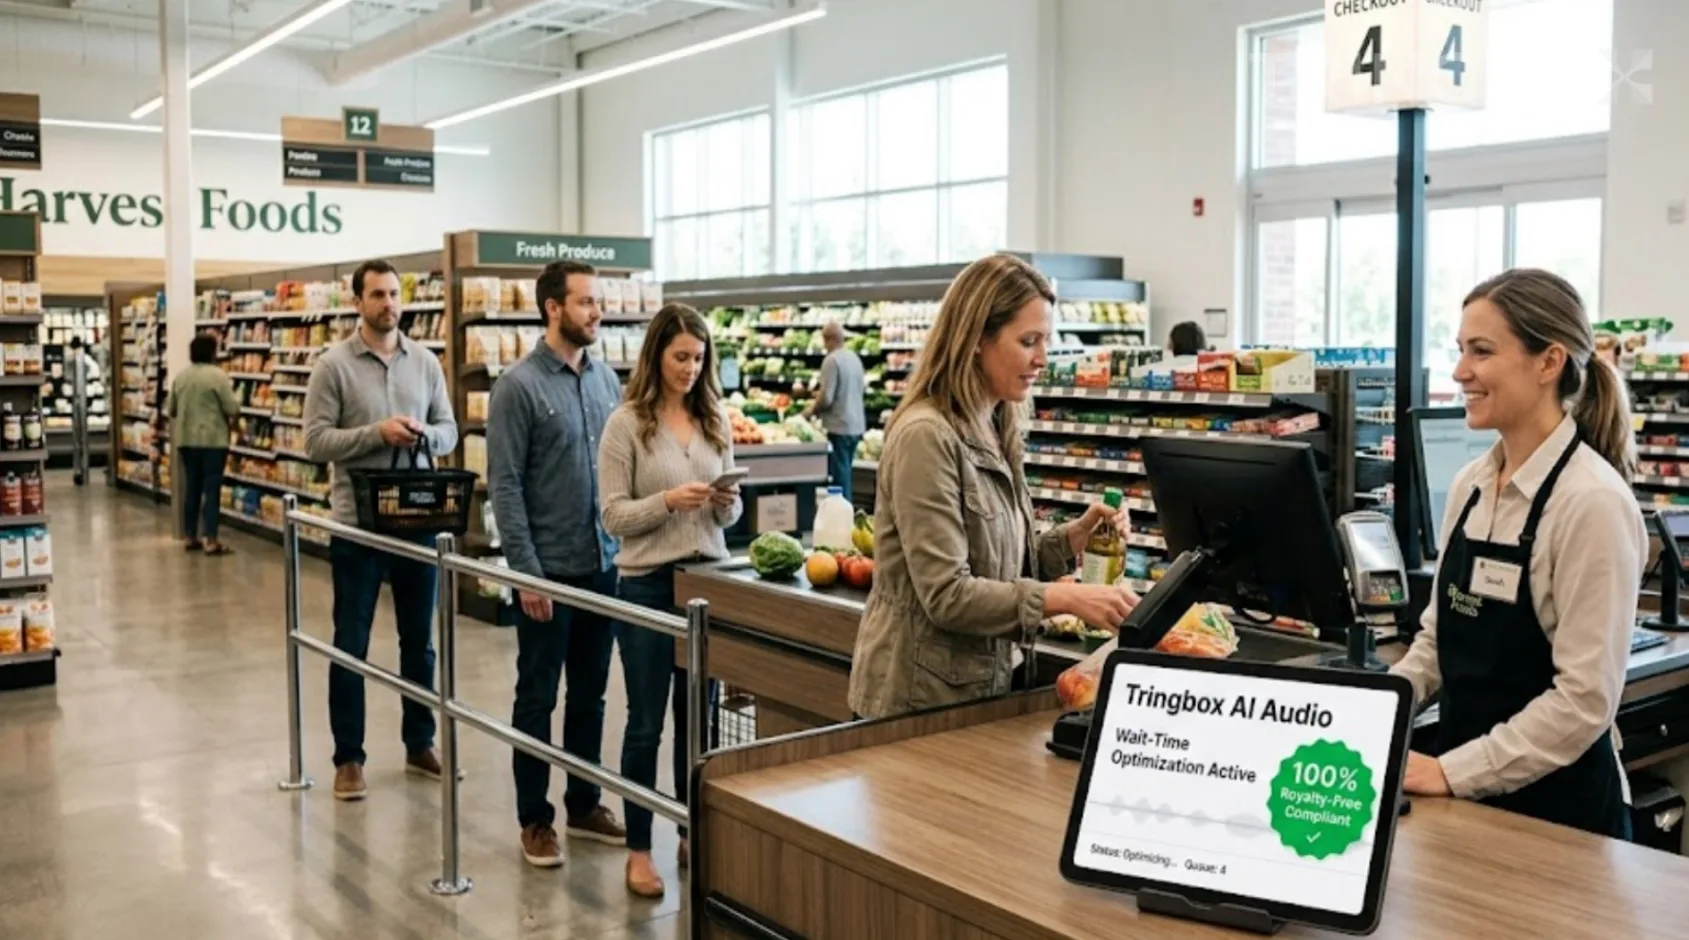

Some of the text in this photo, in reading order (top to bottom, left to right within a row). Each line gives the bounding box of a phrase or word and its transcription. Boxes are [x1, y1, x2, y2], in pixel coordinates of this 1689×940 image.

[1334, 0, 1407, 17] CHECKO
[1426, 0, 1482, 13] CKOUT
[1352, 24, 1387, 87] 4
[1438, 24, 1466, 87] 4
[350, 116, 372, 135] 12
[0, 177, 343, 234] arves Foods
[516, 241, 616, 260] Fresh Produce
[1126, 683, 1333, 728] Tringbox AI Audio
[1115, 727, 1190, 750] Wait-Time
[1111, 749, 1257, 783] Optimization Active
[1292, 761, 1359, 792] 100%
[1280, 787, 1363, 811] Royalty-Free
[1284, 805, 1351, 827] Compliant
